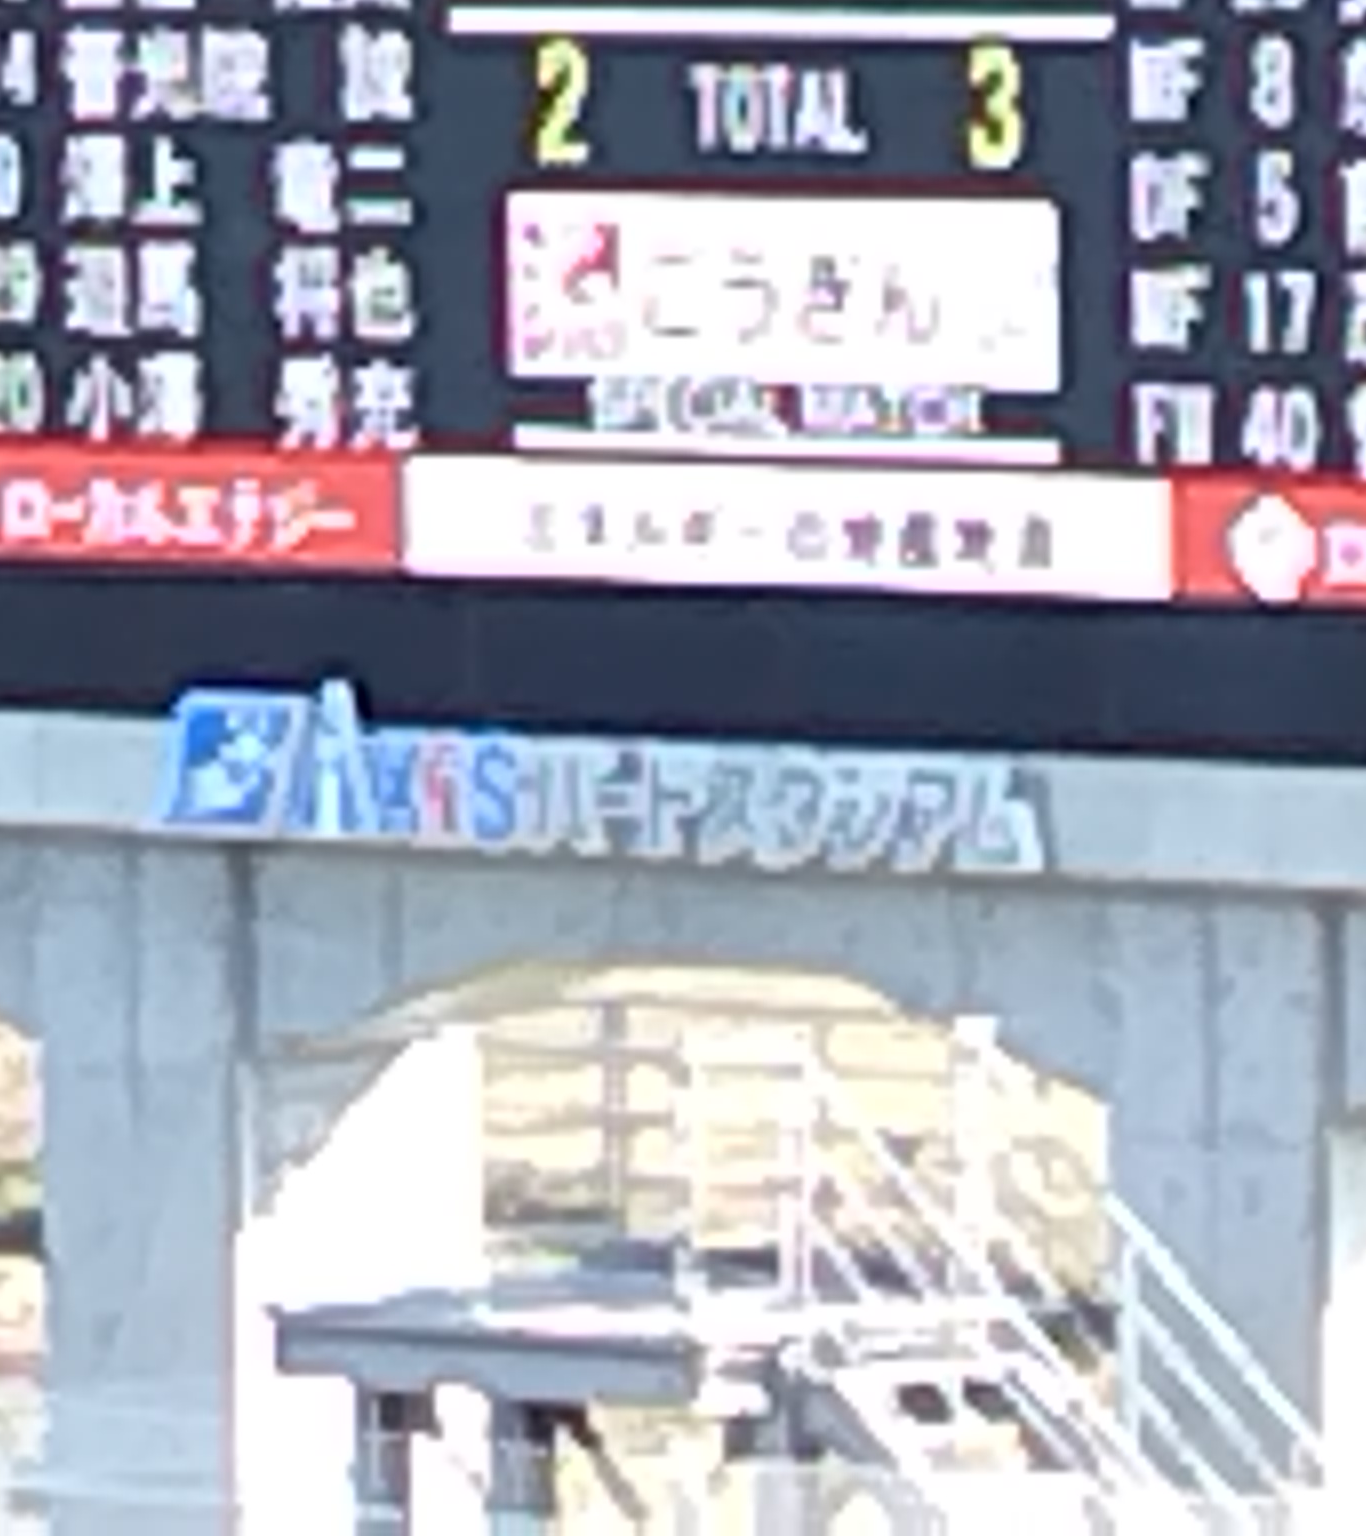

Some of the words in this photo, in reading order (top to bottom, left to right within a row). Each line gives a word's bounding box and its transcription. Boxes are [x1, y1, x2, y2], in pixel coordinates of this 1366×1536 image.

[534, 38, 591, 166] 2
[688, 63, 868, 154] TOTAL
[968, 44, 1023, 170] 3
[1256, 150, 1299, 245] 5
[1245, 270, 1315, 353] 17
[1241, 387, 1320, 472] 40
[1, 476, 356, 554] ローカルエナジー
